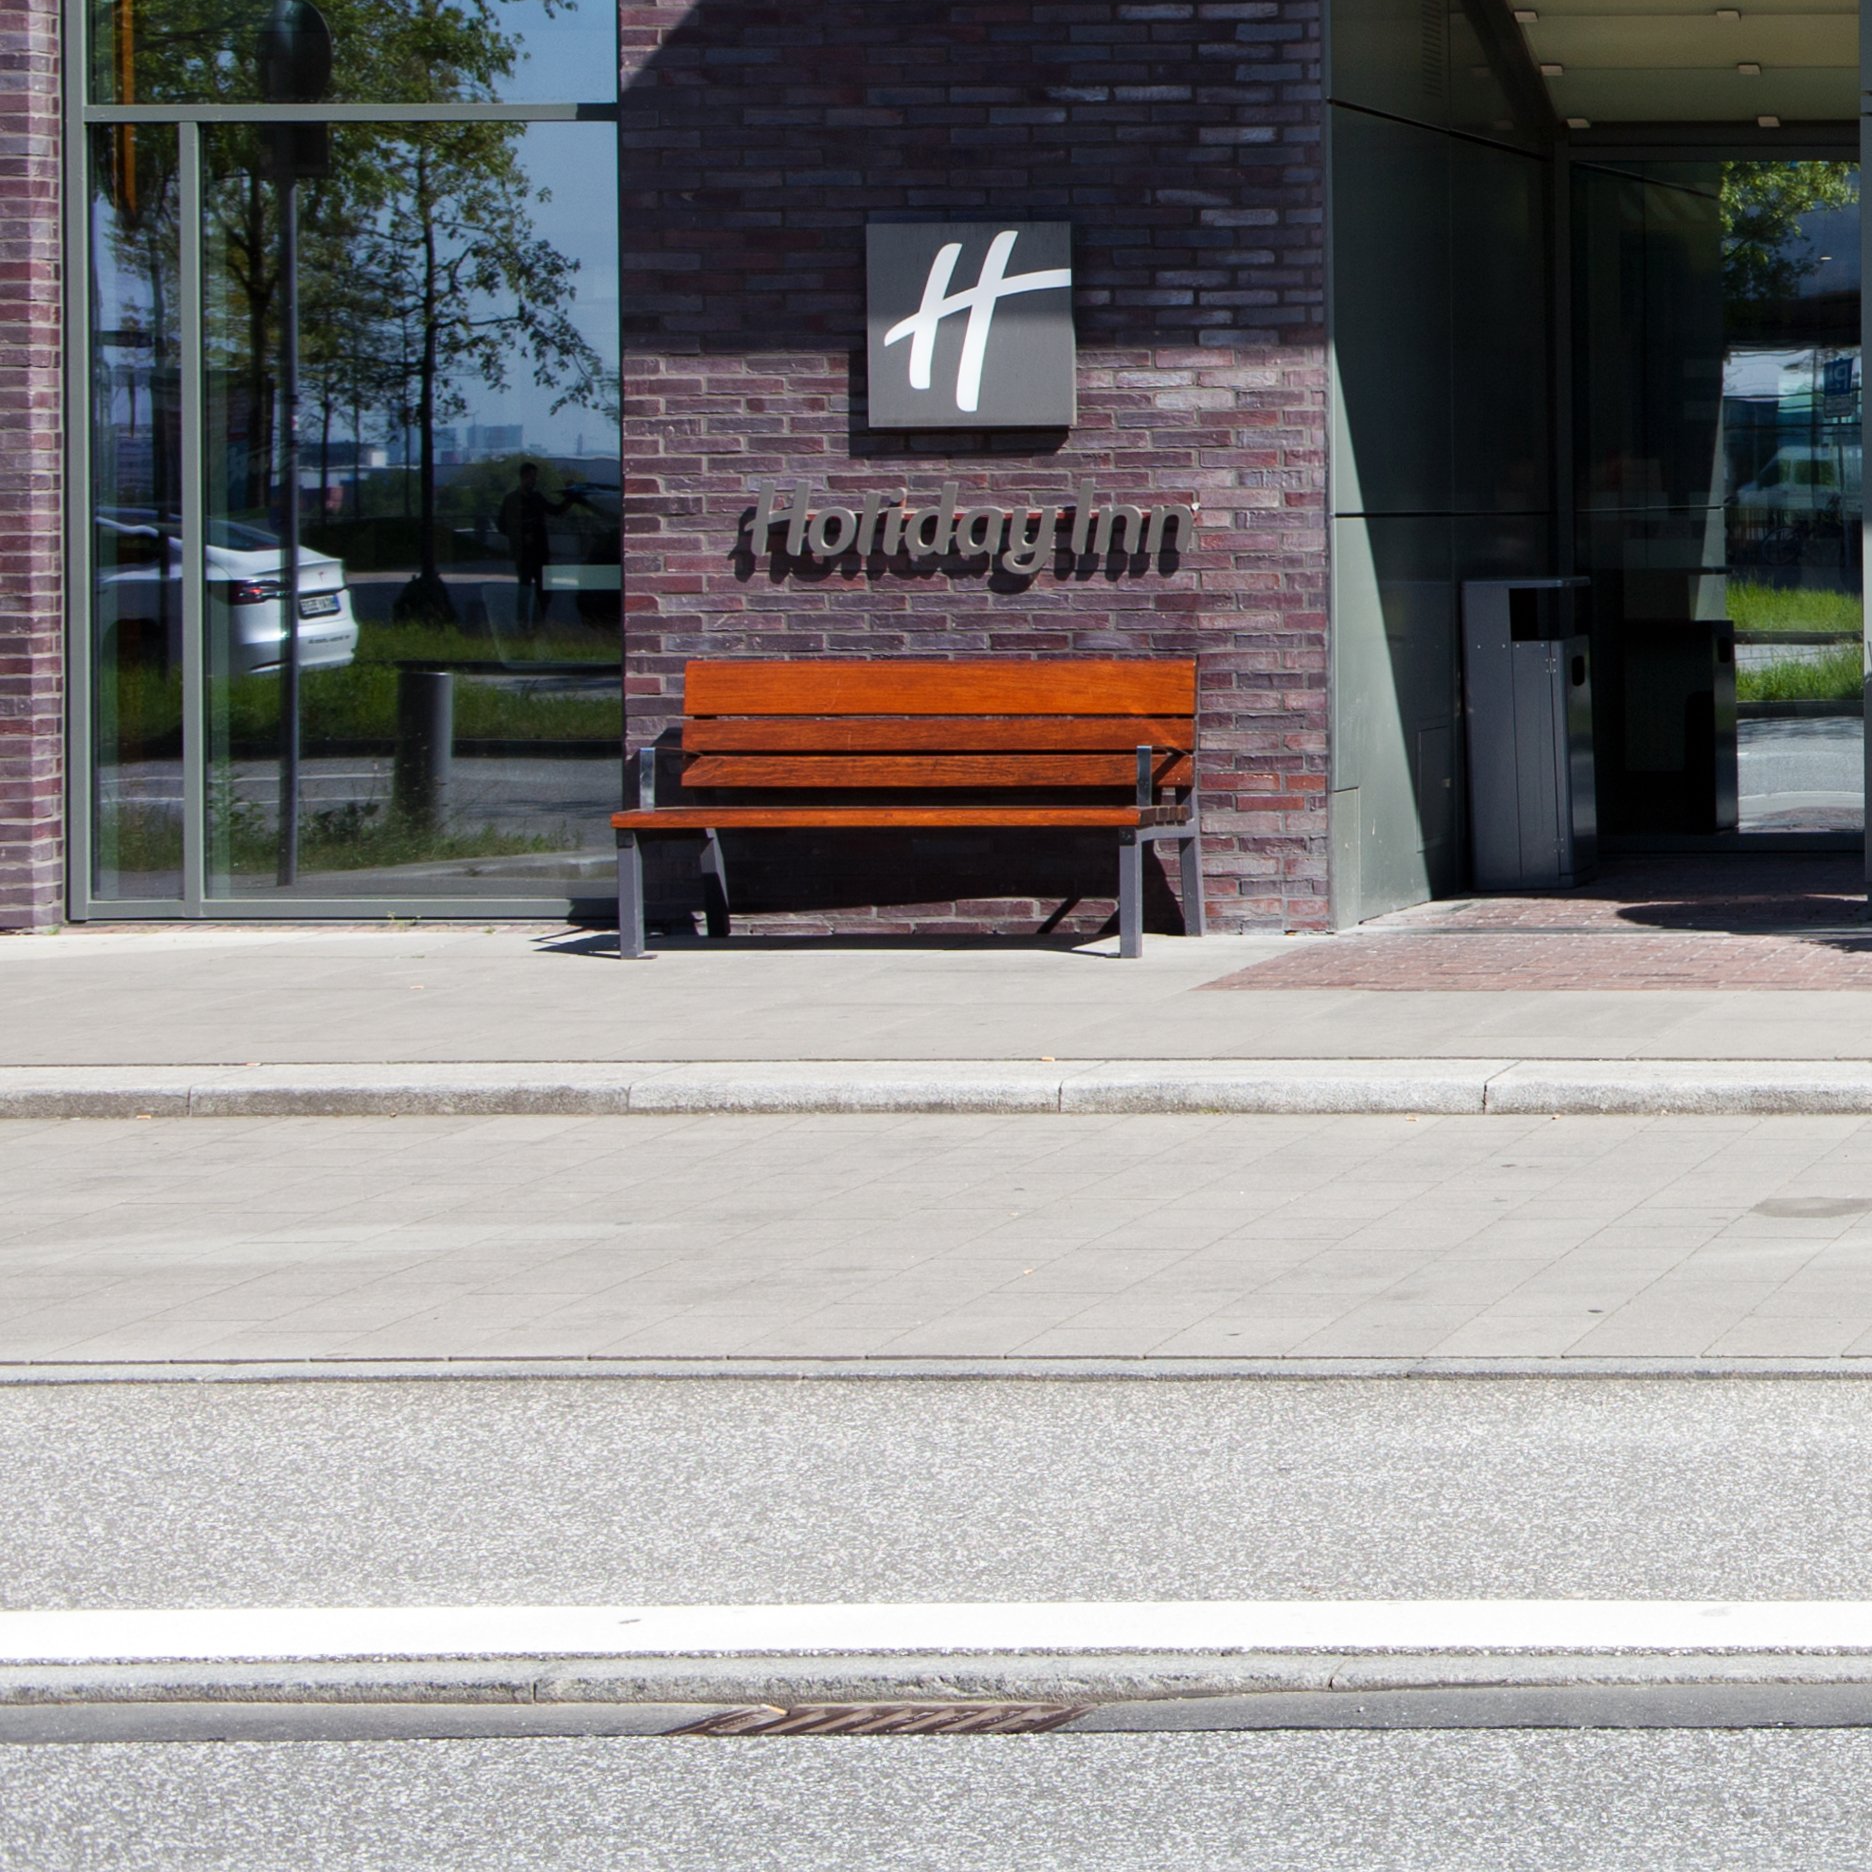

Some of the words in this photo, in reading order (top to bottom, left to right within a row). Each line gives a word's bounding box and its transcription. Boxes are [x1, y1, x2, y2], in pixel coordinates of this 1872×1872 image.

[883, 230, 1071, 413] H
[744, 480, 1057, 576] Holiday
[1070, 478, 1195, 556] Inn
